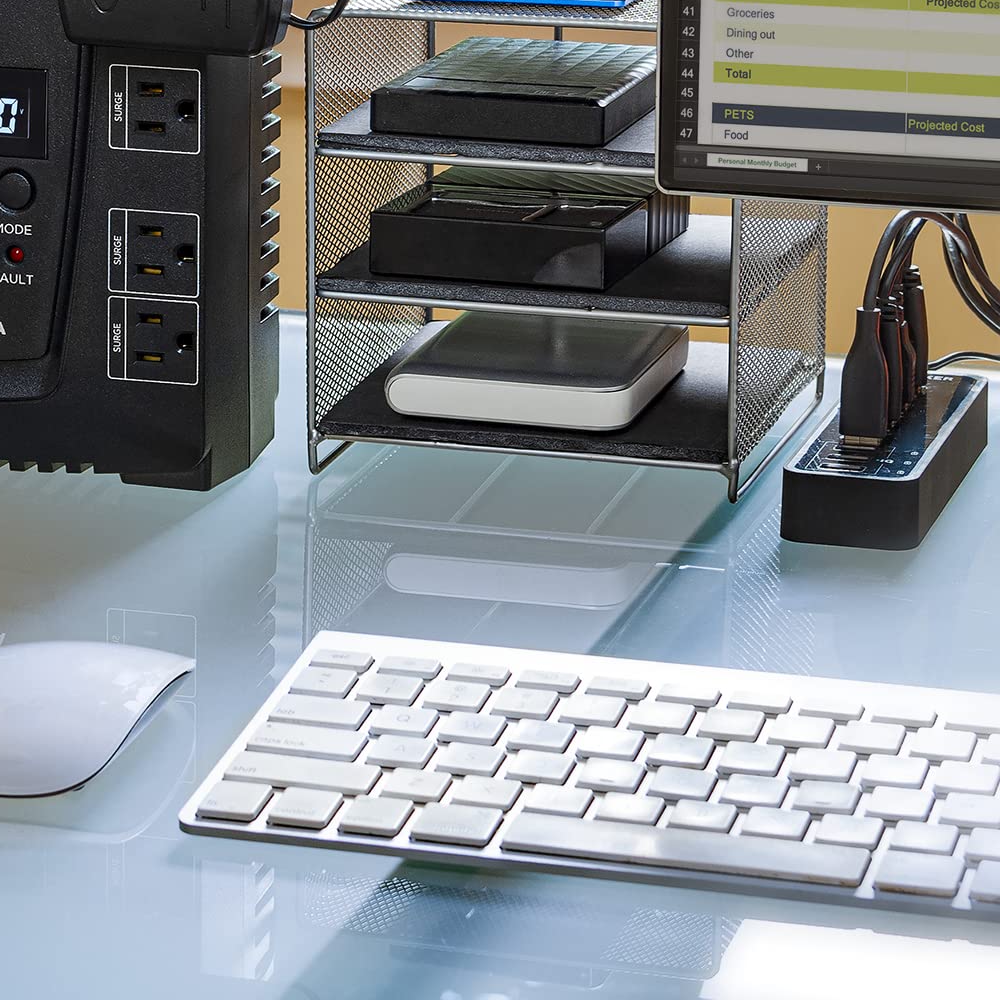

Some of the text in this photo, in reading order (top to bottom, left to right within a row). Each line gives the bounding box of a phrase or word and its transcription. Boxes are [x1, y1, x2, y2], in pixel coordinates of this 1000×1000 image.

[683, 7, 694, 16] 41
[727, 8, 775, 19] Groceries
[682, 27, 694, 37] 42
[727, 28, 775, 40] Dining out
[682, 48, 694, 58] 43
[726, 48, 754, 59] Other
[681, 69, 694, 78] 44
[726, 68, 751, 79] Total
[681, 88, 693, 97] 45
[114, 91, 123, 122] SURGE
[680, 108, 693, 118] 46
[724, 108, 754, 121] PETS
[908, 119, 985, 133] Projected Cost
[680, 128, 692, 138] 47
[724, 129, 748, 141] Food
[718, 157, 745, 165] Personal
[747, 159, 772, 167] Monthly
[113, 235, 122, 265] SURGE
[112, 322, 122, 353] SURGE
